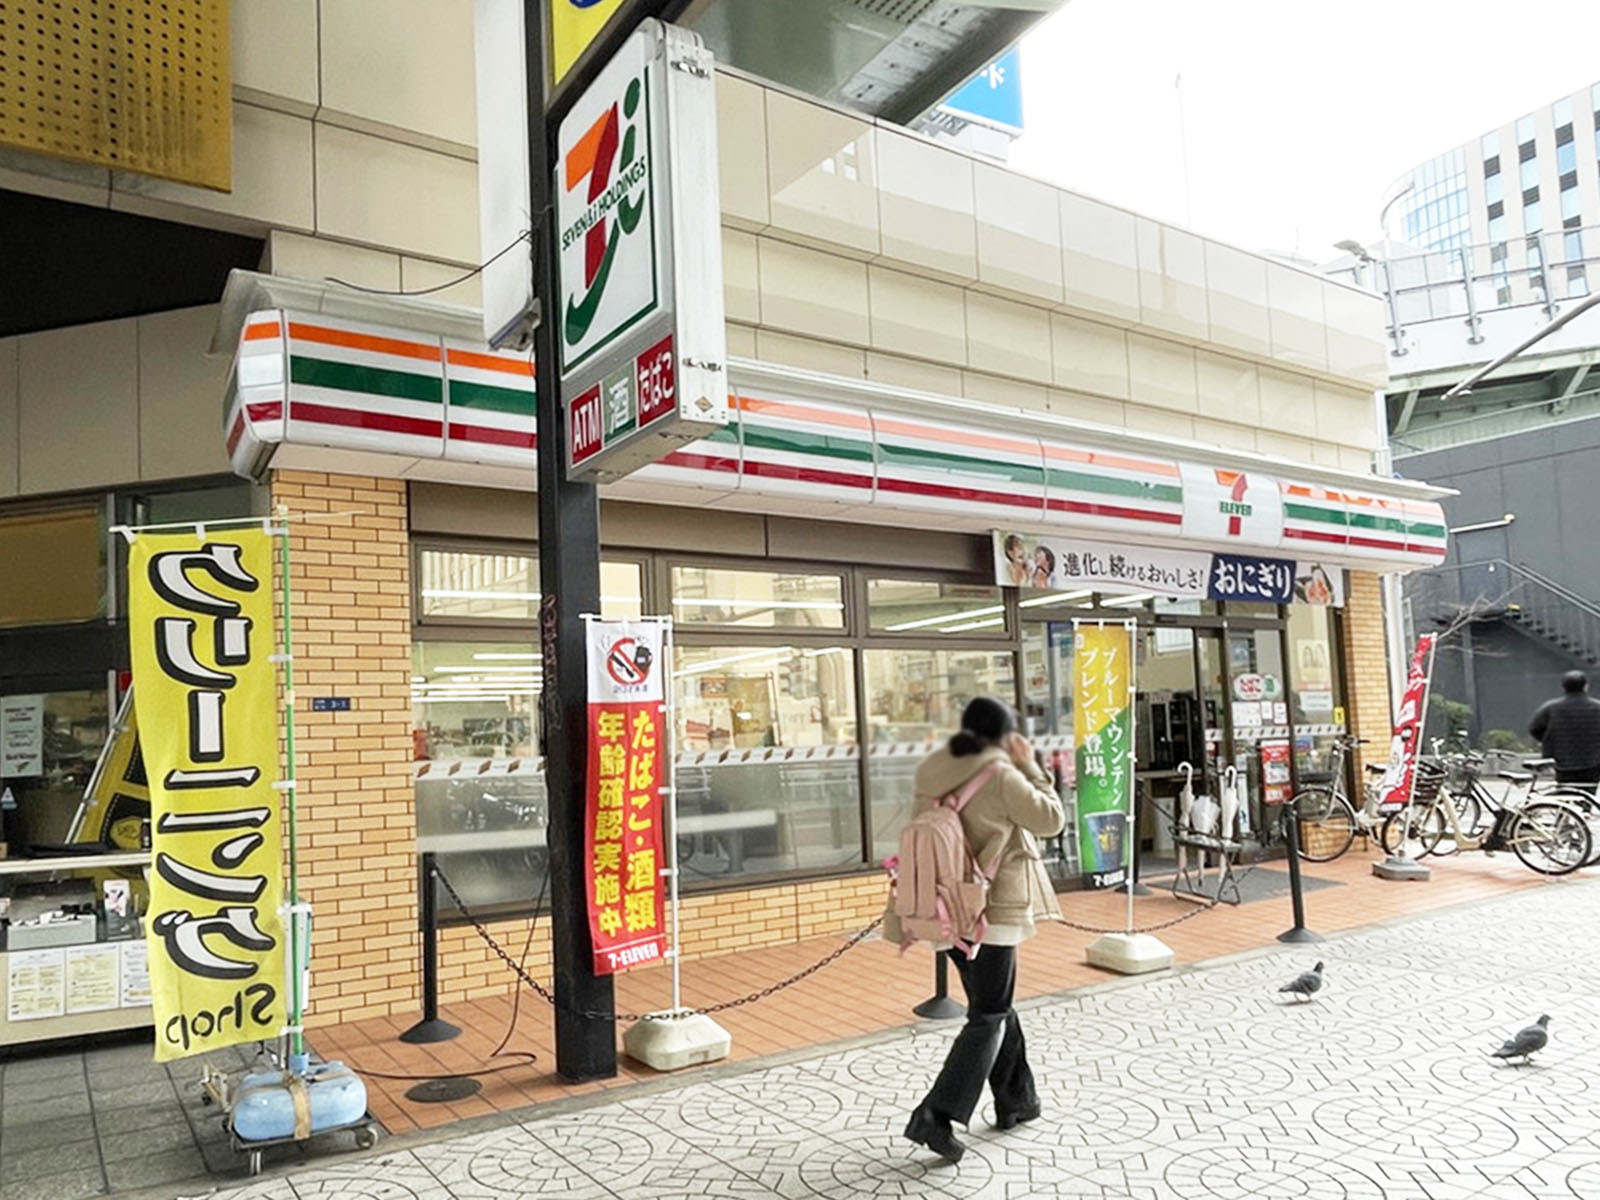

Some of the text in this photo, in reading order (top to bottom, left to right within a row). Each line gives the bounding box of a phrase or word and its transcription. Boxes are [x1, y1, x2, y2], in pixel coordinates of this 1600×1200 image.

[598, 155, 646, 216] HOLDINGS
[608, 377, 630, 434] 酒
[639, 351, 674, 415] たばこ
[573, 397, 600, 453] ATM
[1214, 559, 1293, 599] おにぎり
[1102, 648, 1125, 806] ブルーマウンテン
[594, 712, 626, 938] 年齢確認実施中
[624, 710, 656, 933] たばこ・酒類
